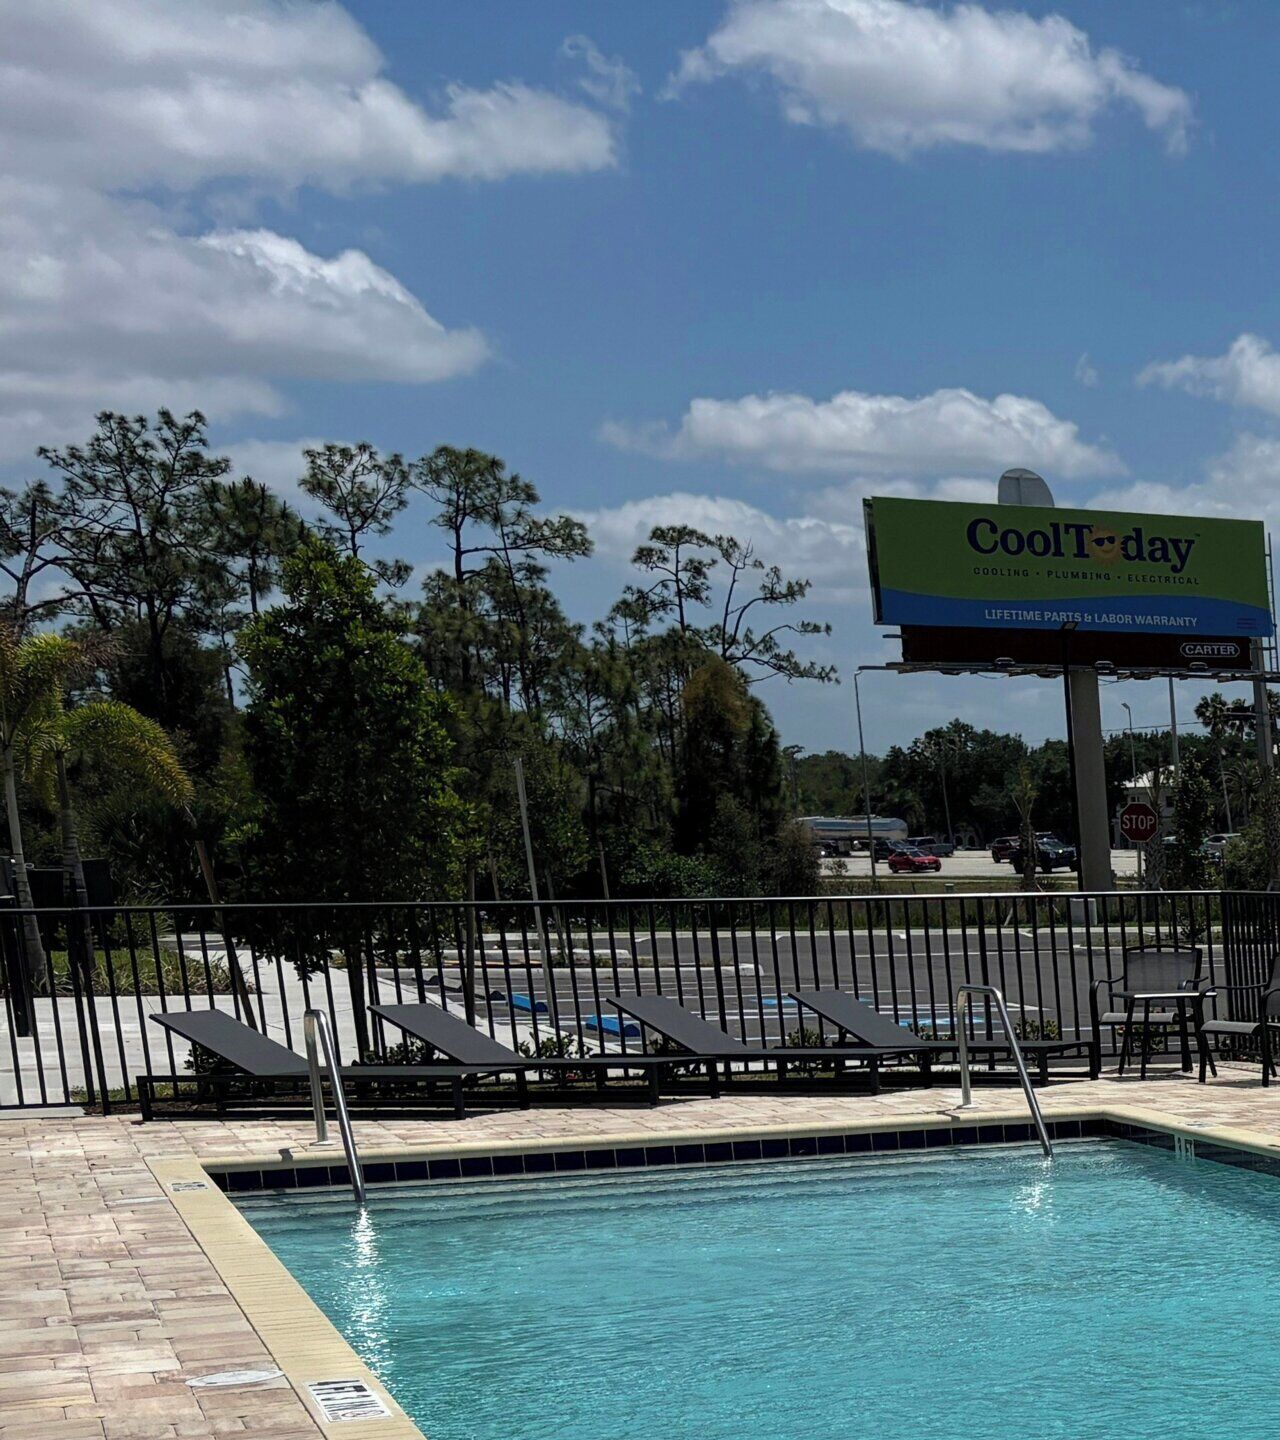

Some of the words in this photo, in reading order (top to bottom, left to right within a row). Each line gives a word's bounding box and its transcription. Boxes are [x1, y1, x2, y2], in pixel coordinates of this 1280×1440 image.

[973, 567, 1029, 577] COOLING
[1047, 570, 1111, 581] PLUMBING
[1128, 574, 1200, 585] ELECTRICAL
[985, 609, 1041, 621] LIFETIME
[1044, 612, 1082, 622] PARTS
[1084, 613, 1091, 623] &
[1095, 613, 1132, 625] LABOR
[1135, 615, 1197, 628] WARRANTY
[1184, 644, 1236, 655] CARTER
[1122, 815, 1154, 830] STOP
